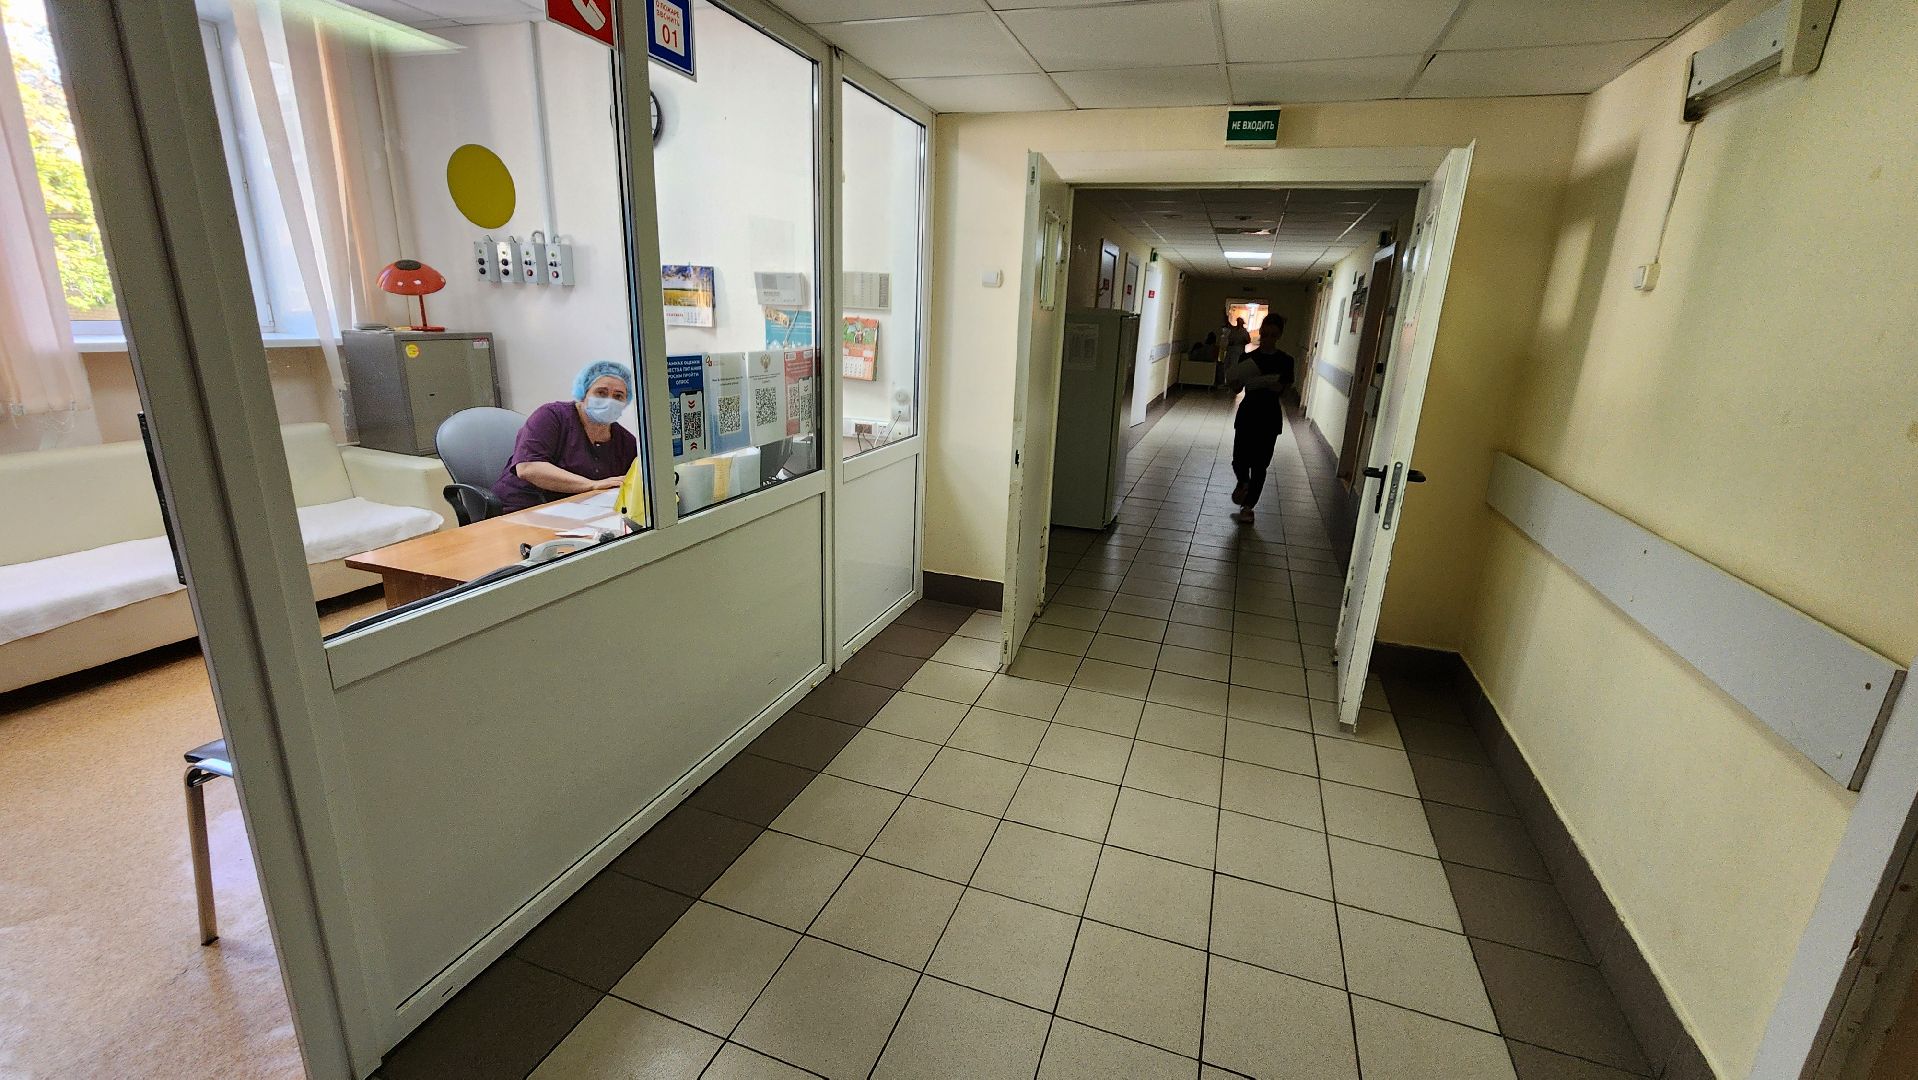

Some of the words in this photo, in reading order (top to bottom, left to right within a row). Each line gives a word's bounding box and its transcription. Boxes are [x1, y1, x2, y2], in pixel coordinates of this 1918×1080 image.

[656, 9, 680, 26] ЗВОНИТЬ
[661, 2, 680, 18] ПОЖАРЕ
[662, 24, 677, 48] 01
[1231, 121, 1241, 130] НЕ
[1242, 120, 1275, 131] ВХОДИТЬ
